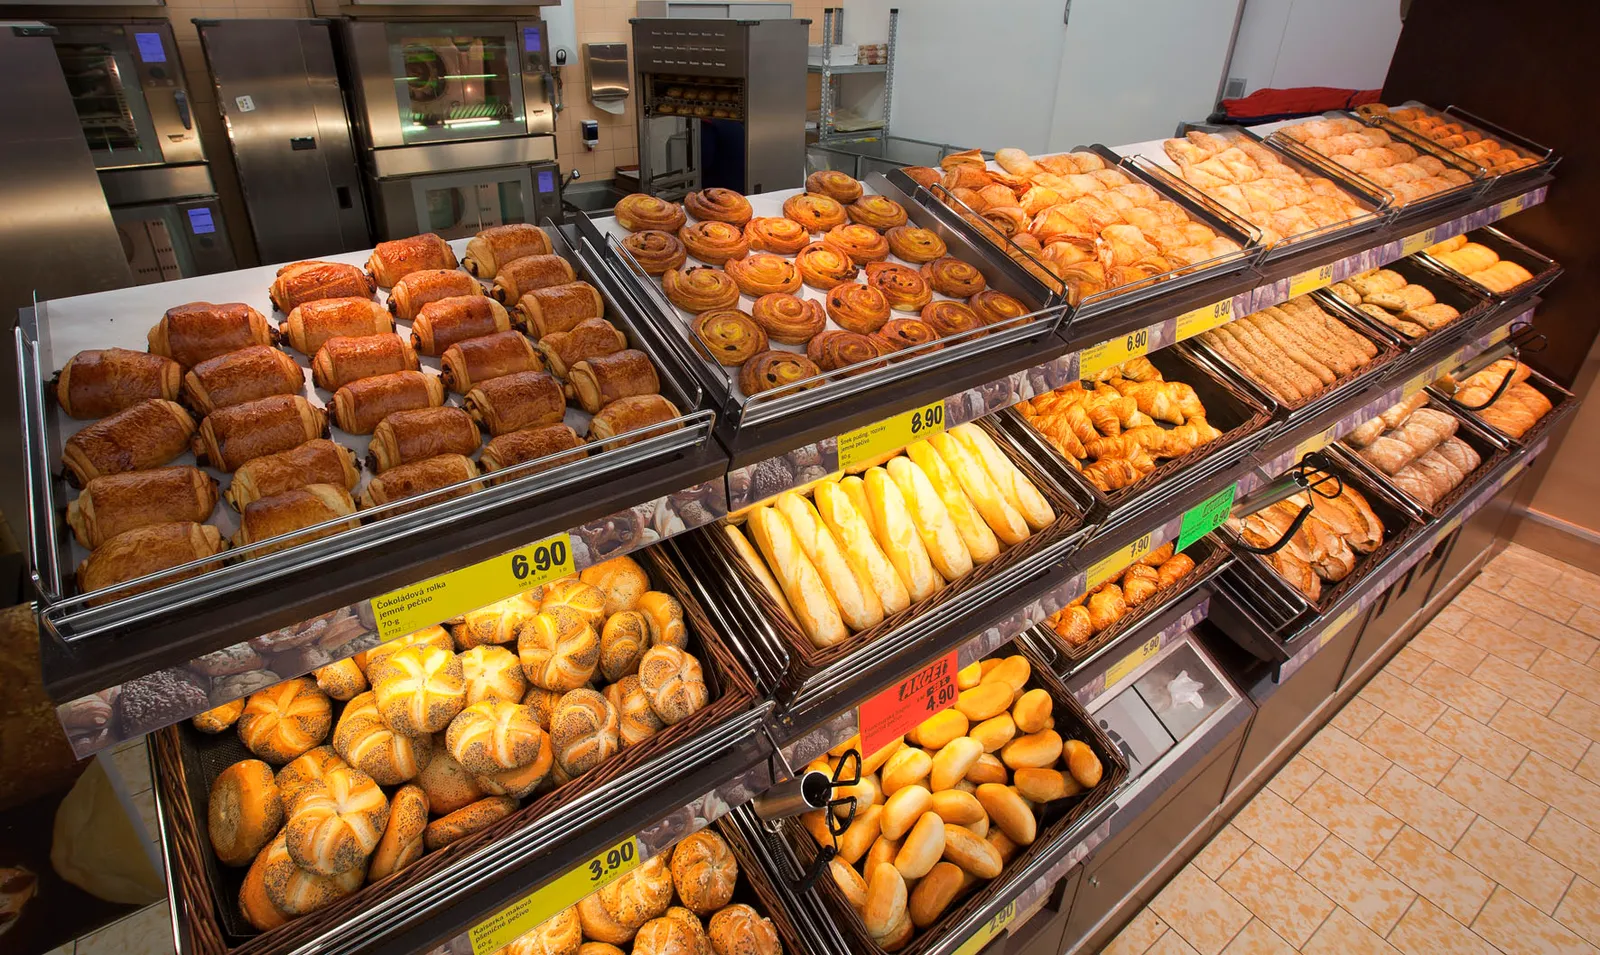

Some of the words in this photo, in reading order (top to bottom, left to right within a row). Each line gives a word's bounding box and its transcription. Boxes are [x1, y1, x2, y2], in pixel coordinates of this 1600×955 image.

[1214, 300, 1230, 318] 9.90
[1127, 331, 1147, 351] 6.90
[911, 405, 942, 433] 8.90
[1131, 535, 1149, 557] 7.90
[511, 541, 566, 579] 6.90
[376, 588, 425, 609] Čokoládová
[426, 581, 447, 593] rolka
[379, 605, 405, 620] jemné
[407, 596, 433, 610] pečivo
[382, 620, 392, 628] 70
[1143, 636, 1159, 656] 5.90
[926, 684, 954, 711] 4.90
[589, 841, 634, 880] 3.90
[473, 915, 504, 936] Kaiserka
[505, 899, 532, 917] maková
[475, 922, 506, 943] pšeničné
[507, 908, 530, 924] pečivo
